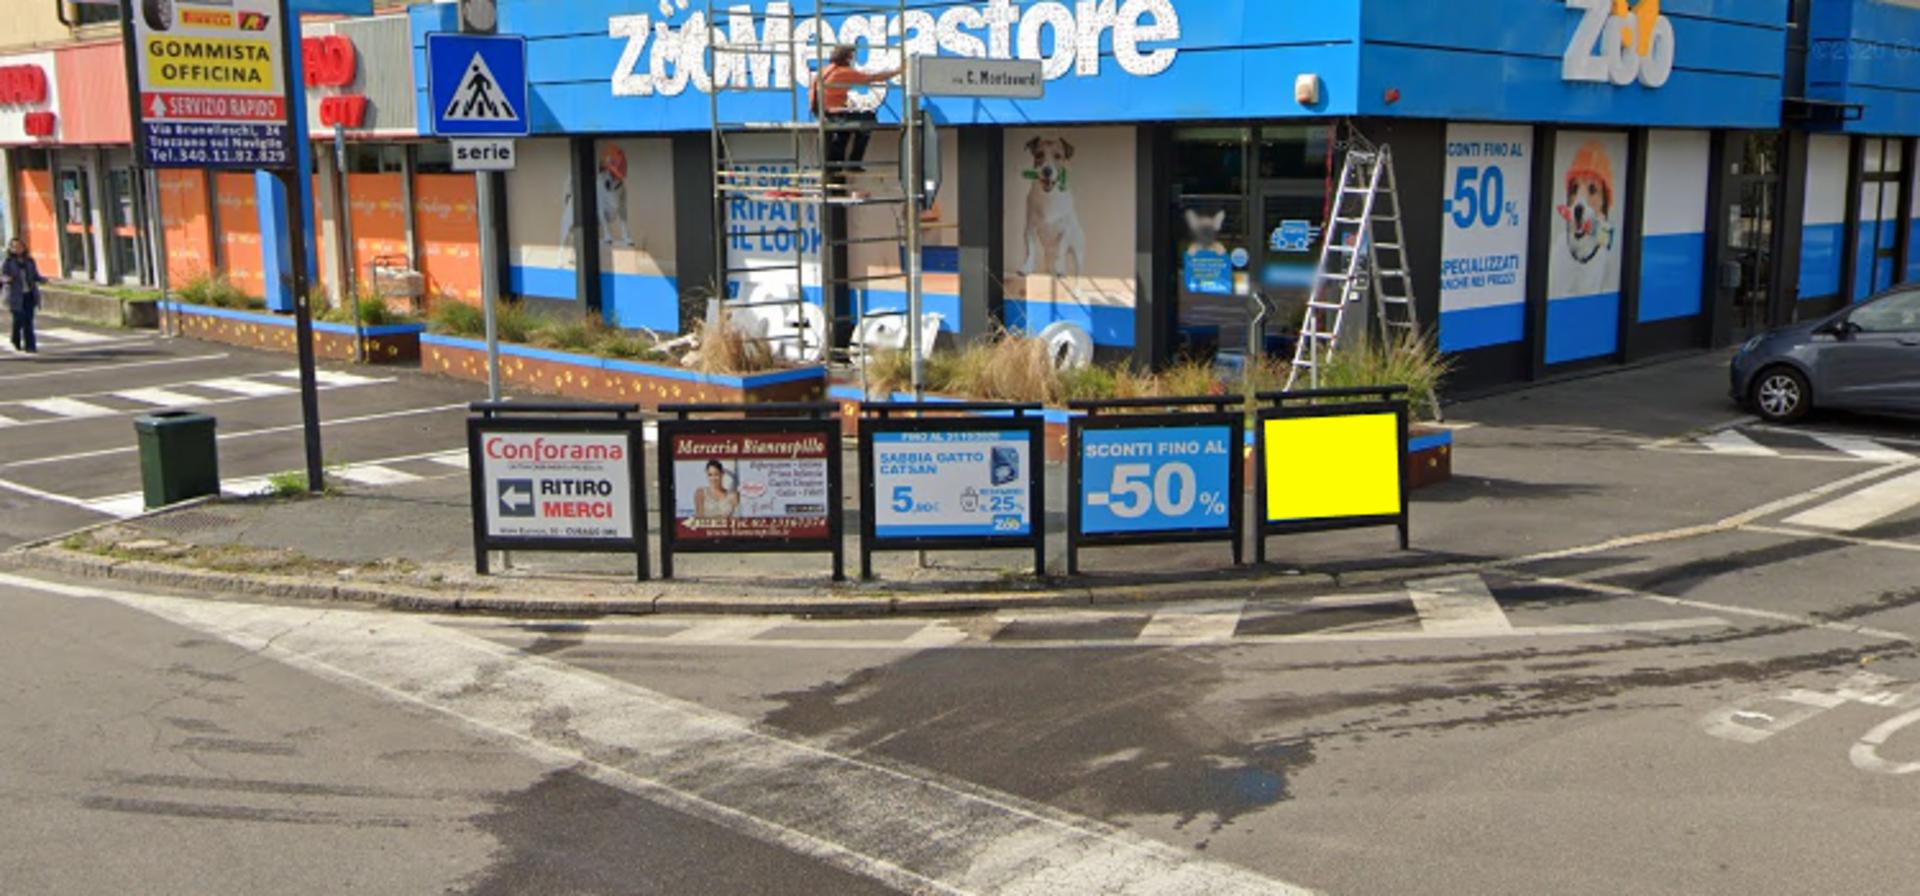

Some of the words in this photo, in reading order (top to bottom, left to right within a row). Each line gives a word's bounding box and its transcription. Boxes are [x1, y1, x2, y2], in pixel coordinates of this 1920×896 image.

[149, 40, 270, 61] GOMMISTA
[161, 63, 262, 82] OFFICINA
[170, 97, 227, 116] SERVIZIO
[230, 99, 278, 117] RAPIDO
[150, 124, 172, 136] Via
[457, 143, 511, 160] serie
[1510, 143, 1523, 157] AL
[731, 224, 754, 250] IL
[485, 436, 624, 463] Conforama
[880, 452, 933, 463] SABBIA
[937, 451, 984, 462] GATTO
[1086, 443, 1153, 458] SCONTI
[1158, 442, 1200, 456] FINO
[1204, 440, 1228, 455] AL
[541, 478, 613, 496] RITIRO
[542, 501, 613, 519] MERCI
